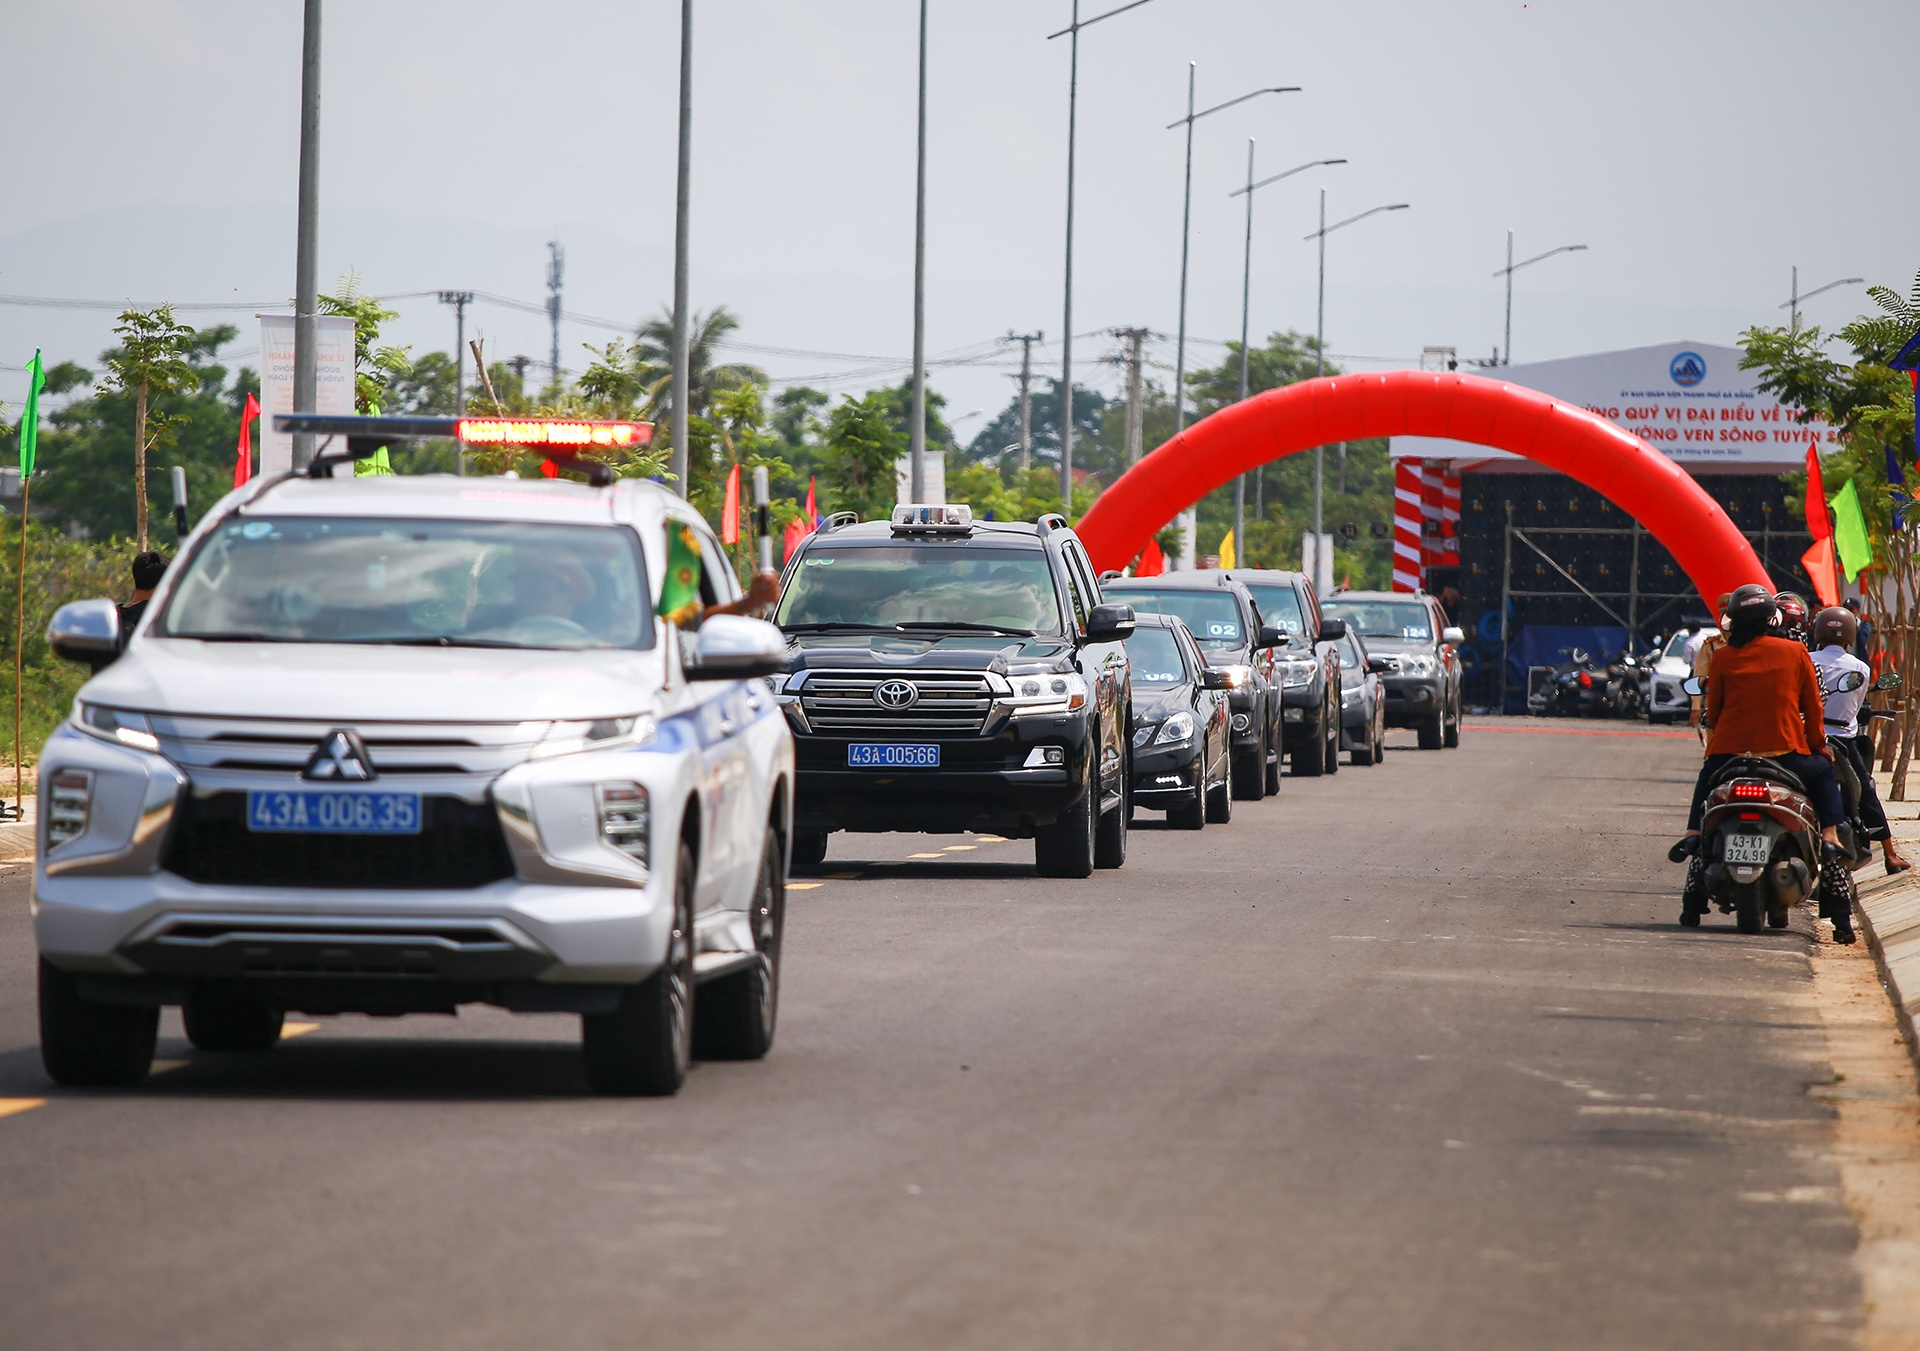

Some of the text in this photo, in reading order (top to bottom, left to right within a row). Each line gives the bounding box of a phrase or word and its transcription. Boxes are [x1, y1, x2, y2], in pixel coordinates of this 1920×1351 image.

[1625, 403, 1659, 420] QUÝ
[1664, 407, 1681, 423] VỊ
[1686, 407, 1715, 425] ĐẠI
[1721, 402, 1754, 421] BIỂU
[1761, 402, 1780, 421] VỀ
[1684, 428, 1714, 442] VEN
[1719, 426, 1767, 443] SÔNG
[1772, 427, 1821, 443] TUYÊN
[1210, 624, 1236, 636] 02
[1277, 620, 1298, 632] 03
[851, 746, 937, 765] 43A-005.66
[1732, 835, 1763, 849] 43-K1
[1727, 849, 1766, 862] 324.98
